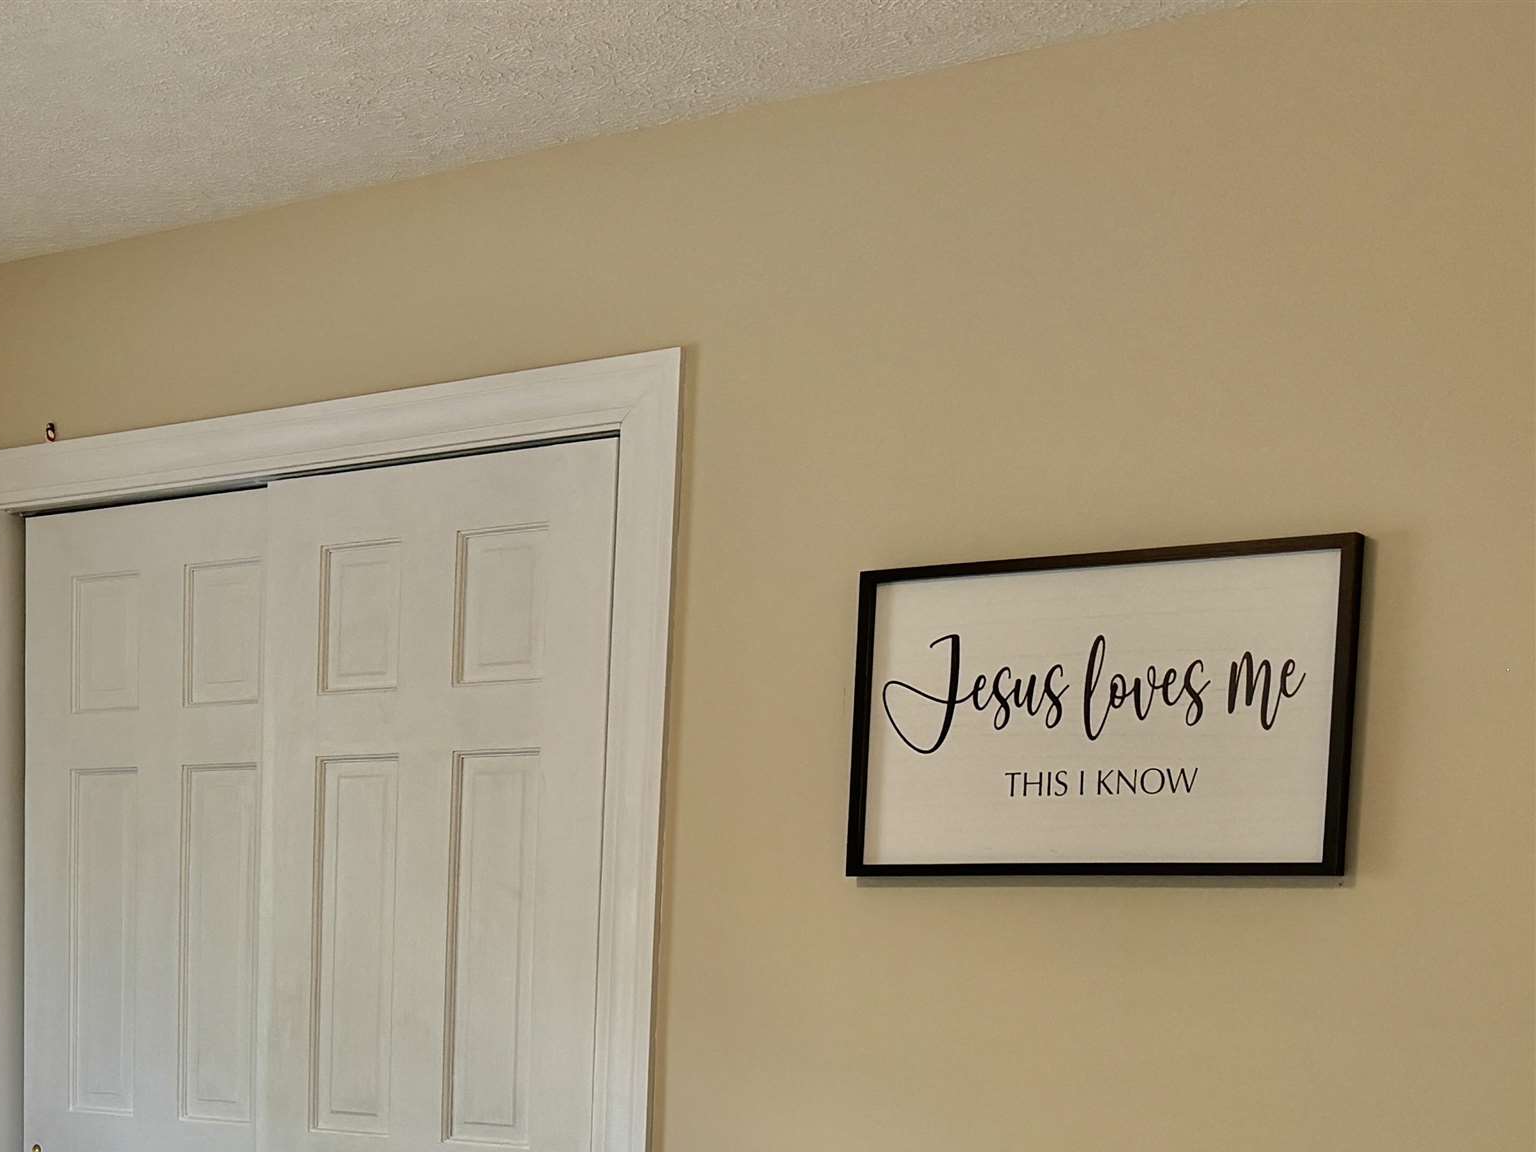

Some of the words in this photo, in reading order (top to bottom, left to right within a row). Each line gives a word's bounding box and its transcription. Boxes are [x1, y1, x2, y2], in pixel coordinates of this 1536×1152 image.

[883, 634, 1069, 754] Jesus
[1084, 635, 1210, 740] loves
[1228, 652, 1306, 730] me
[1005, 771, 1067, 797] THIS
[1080, 771, 1084, 795] I
[1097, 768, 1198, 795] KNOW
